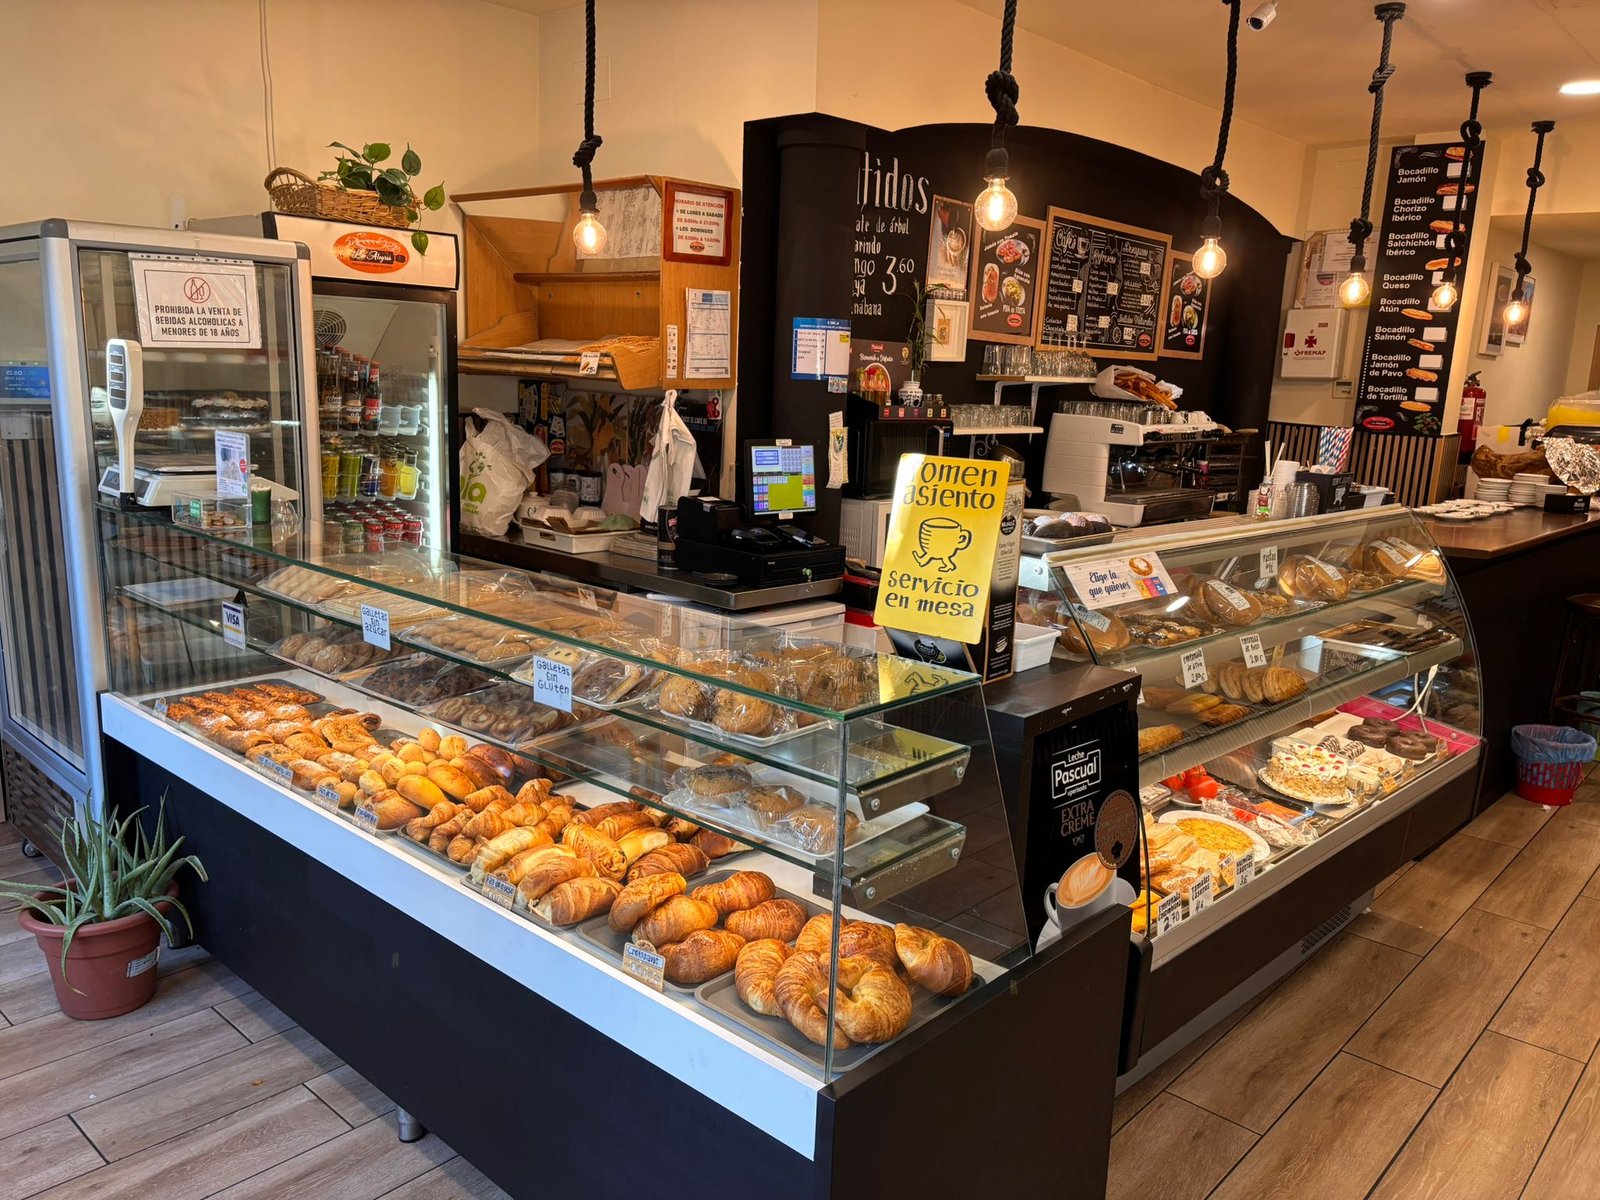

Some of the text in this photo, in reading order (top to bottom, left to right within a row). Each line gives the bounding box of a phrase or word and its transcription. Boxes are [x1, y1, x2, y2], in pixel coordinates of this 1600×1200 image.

[1397, 175, 1426, 183] Jamón
[1398, 167, 1438, 176] Bocadillo
[856, 151, 929, 214] tidos
[1394, 197, 1435, 205] Bocadillo
[876, 215, 886, 233] de
[889, 216, 910, 234] árbol
[155, 305, 241, 316] PROHIBIDA LA VENTA DE
[156, 316, 185, 325] BEBIDAS
[189, 317, 236, 326] ALCOHOLICAS
[162, 328, 196, 336] MENORES
[221, 327, 239, 337] AÑOS
[1368, 385, 1407, 394] Bocadillo
[903, 484, 995, 510] asiento
[888, 570, 979, 598] servicio
[1089, 570, 1118, 584] Elige la
[1089, 581, 1130, 598] que quieres
[885, 592, 908, 609] en
[916, 599, 974, 617] mesa
[226, 611, 240, 626] VISA
[1068, 751, 1084, 762] Leche
[1055, 755, 1097, 787] Pascual
[1062, 800, 1094, 823] EXTRA
[1061, 812, 1095, 837] CREME
